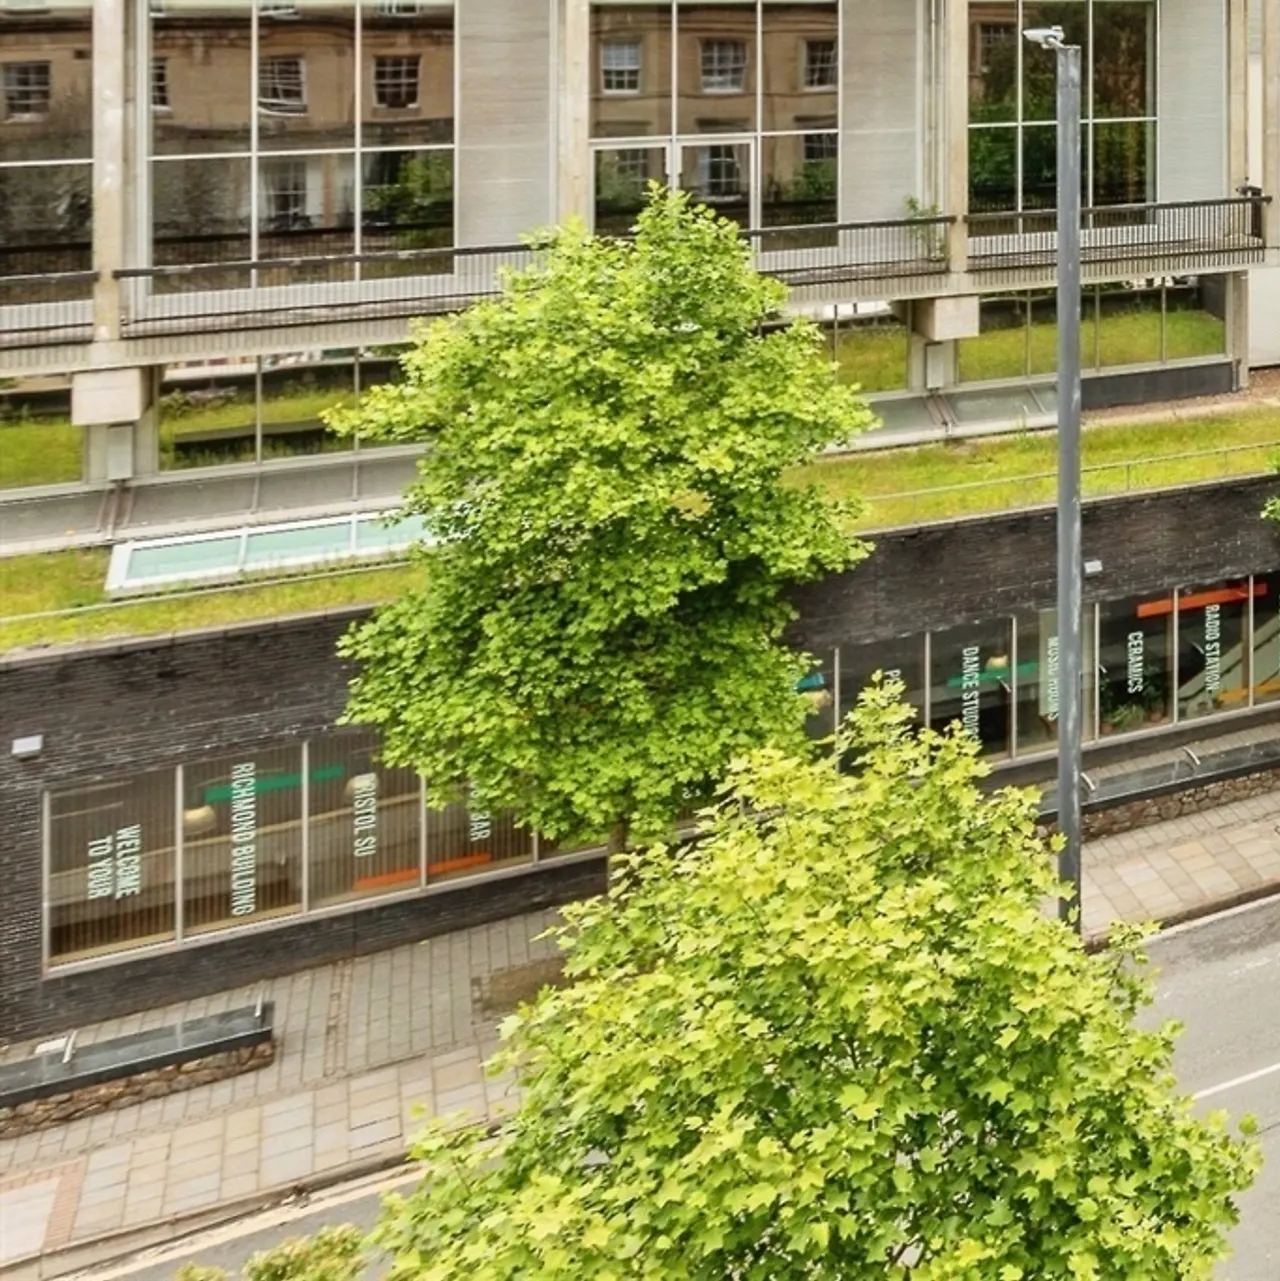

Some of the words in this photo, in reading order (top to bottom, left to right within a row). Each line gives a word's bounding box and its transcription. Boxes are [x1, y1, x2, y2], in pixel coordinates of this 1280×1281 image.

[1205, 604, 1220, 641] RADIO
[962, 646, 980, 689] DANCE
[1127, 631, 1143, 694] CERAMICS
[1205, 642, 1220, 691] STATION
[231, 762, 256, 844] RICHMOND
[88, 835, 113, 857] TO
[115, 823, 141, 900] WELCOME
[353, 836, 377, 857] SU
[88, 857, 113, 900] YOUR
[231, 844, 256, 915] BUILDING
